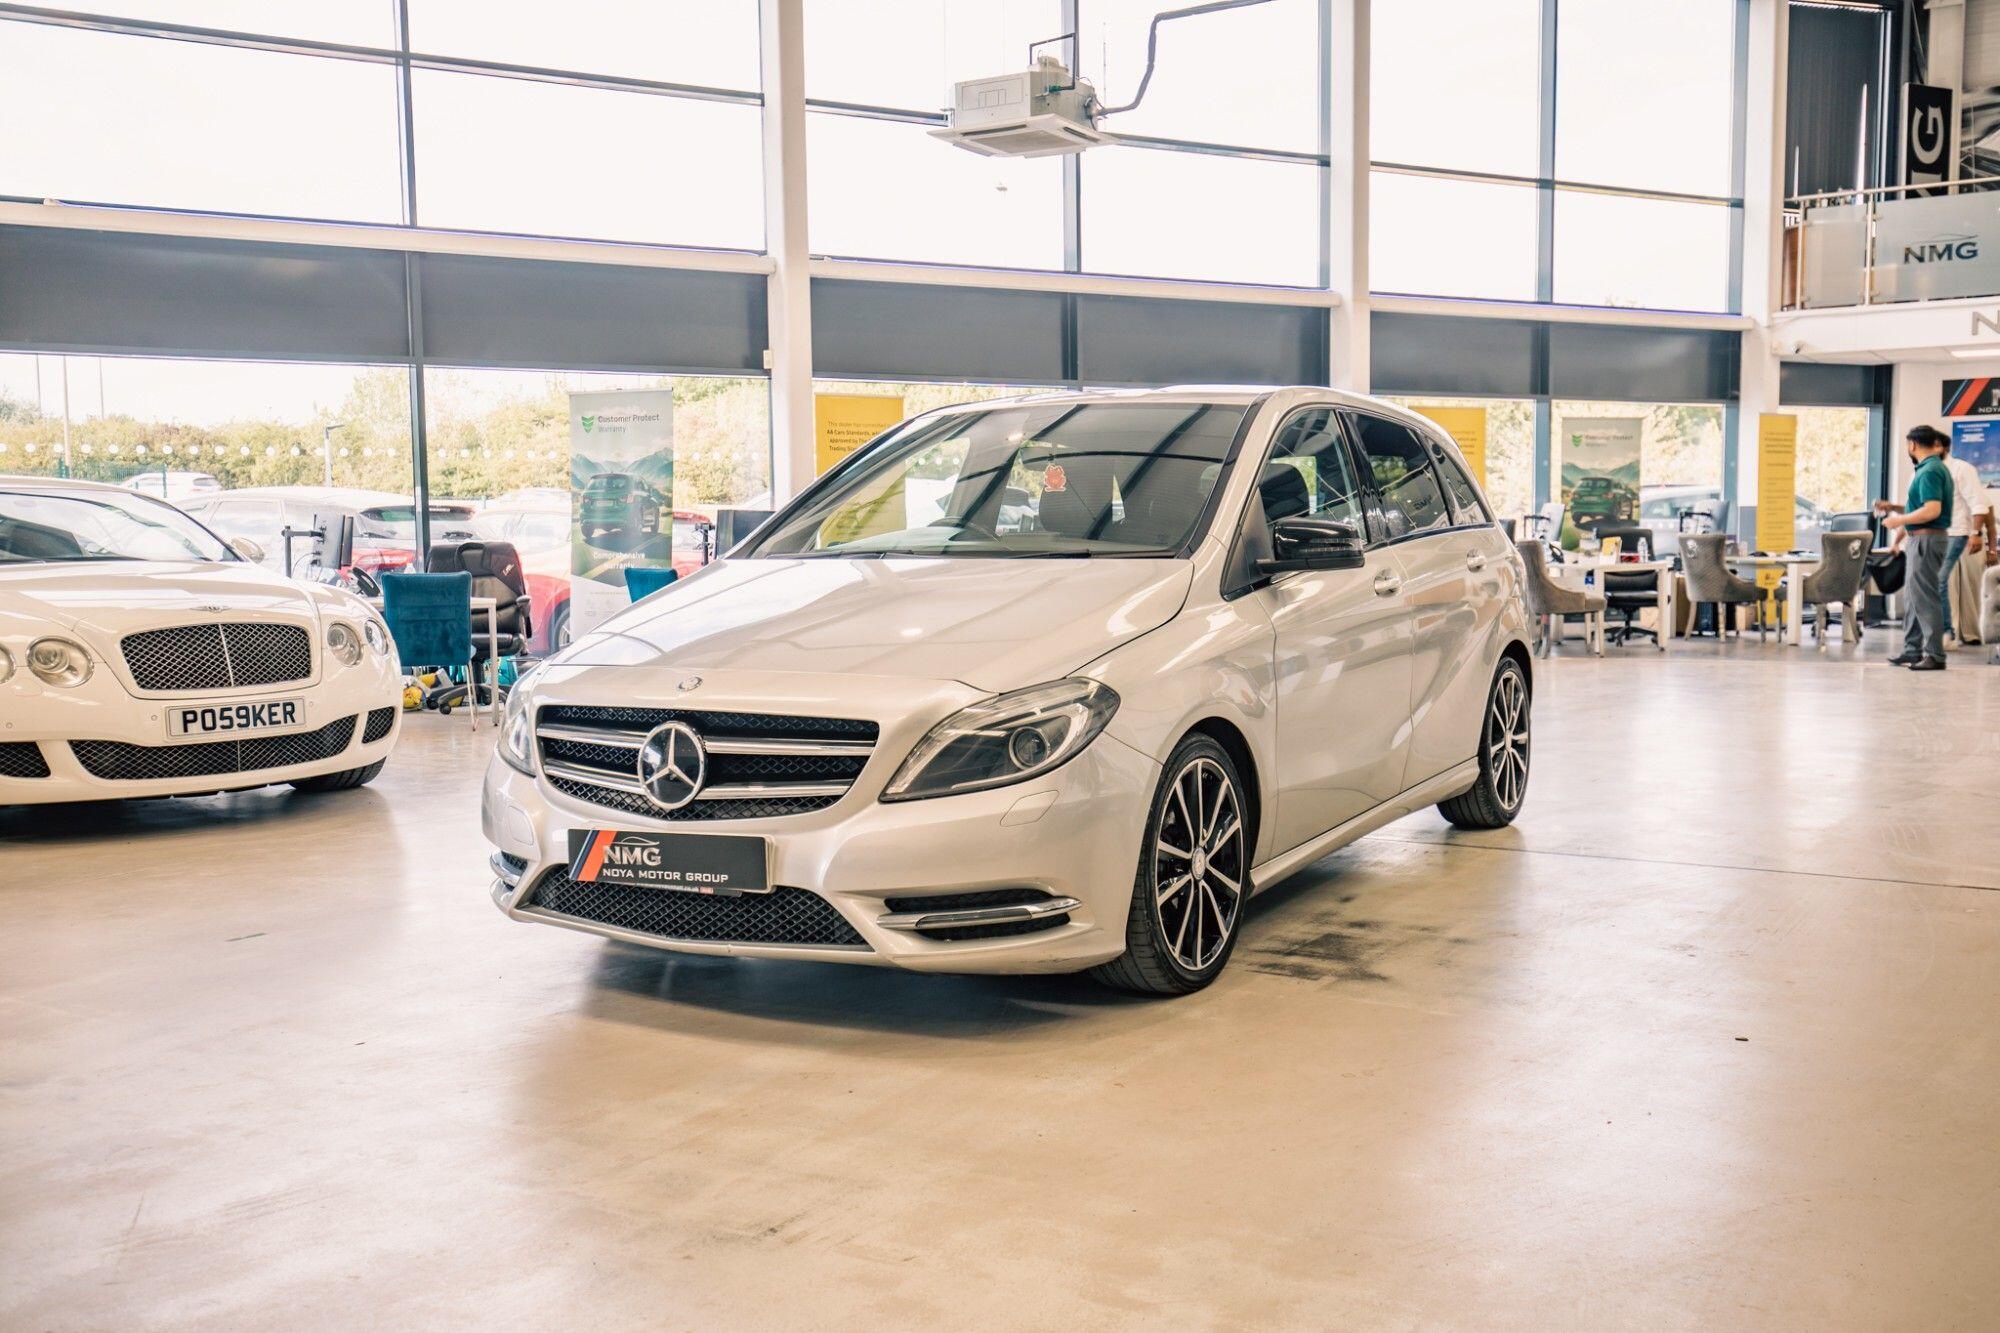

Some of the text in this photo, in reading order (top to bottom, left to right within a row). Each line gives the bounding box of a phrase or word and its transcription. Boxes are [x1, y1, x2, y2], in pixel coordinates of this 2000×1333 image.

[1904, 241, 1979, 264] NMG
[597, 413, 660, 423] Customer Protect
[182, 701, 296, 733] PO59KER
[603, 845, 662, 866] NMG
[603, 868, 729, 883] NOYA MOTOR GROUP
